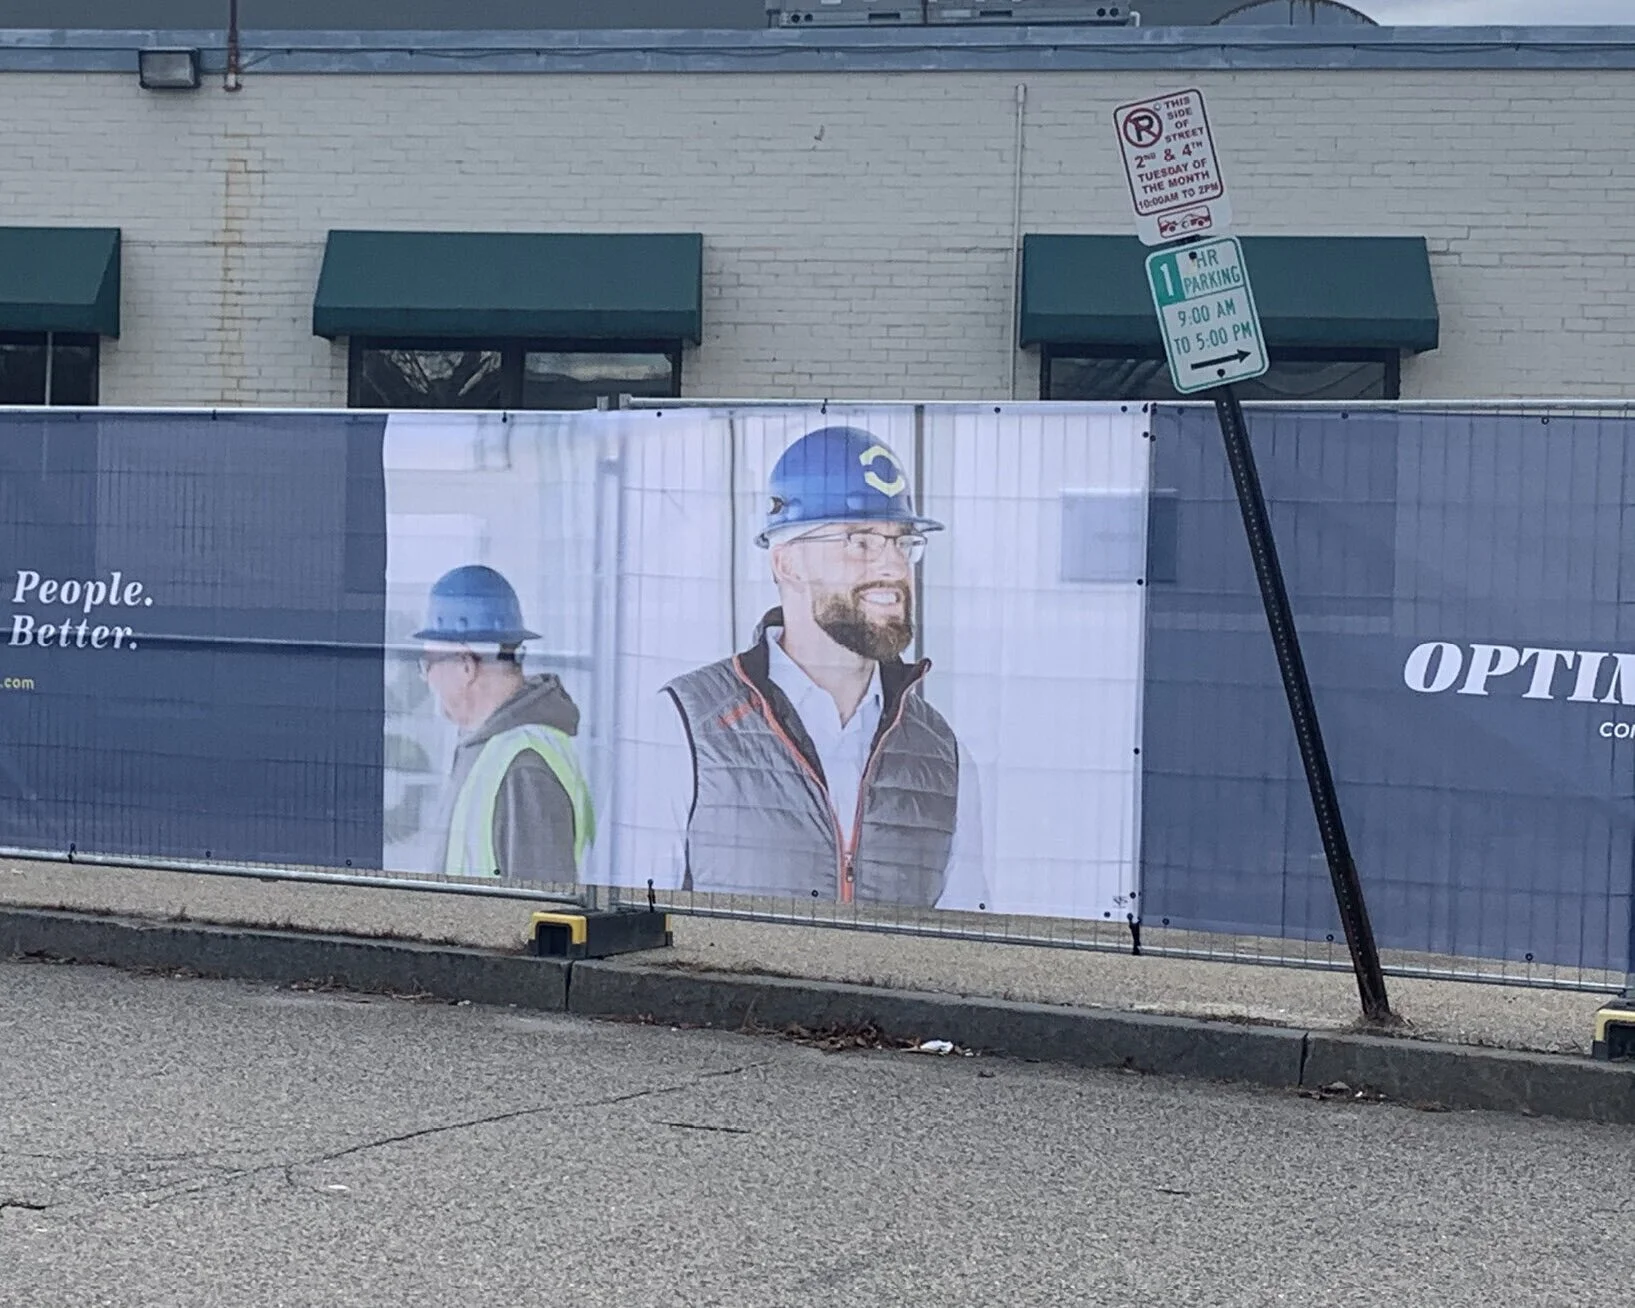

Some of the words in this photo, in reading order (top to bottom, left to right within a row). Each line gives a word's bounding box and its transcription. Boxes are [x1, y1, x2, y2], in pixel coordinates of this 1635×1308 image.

[1164, 97, 1190, 109] THIS
[1167, 108, 1192, 120] SIDE
[1165, 127, 1204, 143] STREET
[1175, 119, 1189, 129] OF
[1164, 148, 1175, 162] &
[1138, 163, 1188, 183] TUESDAY
[1193, 158, 1207, 169] OF
[1142, 180, 1165, 194] THE
[1168, 171, 1210, 188] MONTH
[1139, 192, 1179, 209] 10:00AM
[1183, 188, 1196, 198] TO
[1199, 182, 1220, 194] 2PM
[1197, 249, 1219, 268] HR
[1160, 263, 1173, 297] 1
[1184, 265, 1240, 295] PARKING
[1178, 305, 1210, 327] 9:00
[1217, 298, 1236, 318] AM
[1174, 336, 1191, 355] TO
[1196, 327, 1228, 350] 5:00
[1233, 321, 1252, 341] PM
[12, 570, 153, 613] People.
[8, 614, 138, 650] Better.
